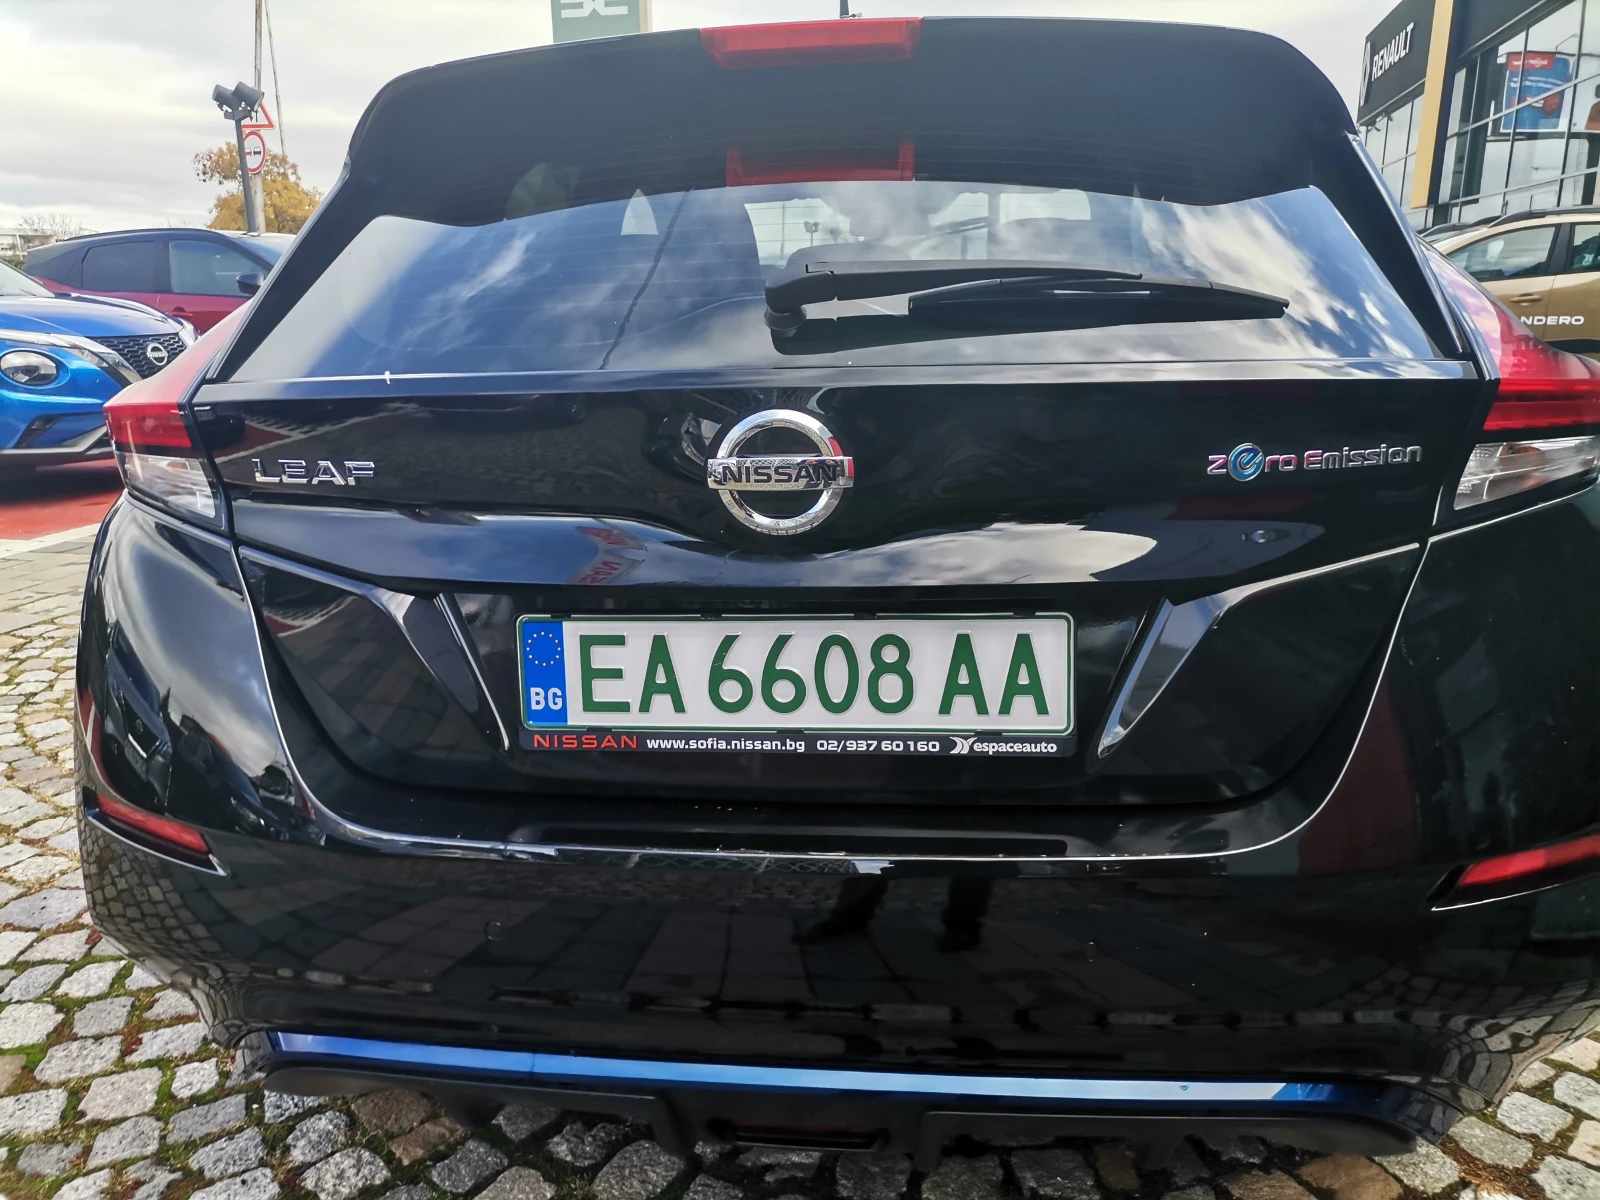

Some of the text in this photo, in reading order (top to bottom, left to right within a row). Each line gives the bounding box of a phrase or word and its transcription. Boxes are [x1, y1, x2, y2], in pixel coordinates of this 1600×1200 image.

[1371, 22, 1414, 82] RENAULT
[1520, 315, 1585, 326] NDERO
[251, 458, 375, 486] LEAF
[721, 465, 838, 484] NISSAN
[1206, 442, 1423, 482] zero Emission
[579, 632, 1050, 715] EA 6608 AA
[530, 687, 563, 710] BG
[533, 734, 638, 749] NISSAN
[646, 738, 805, 753] www.sofia.nissan.bg
[973, 740, 1058, 755] espaceauto
